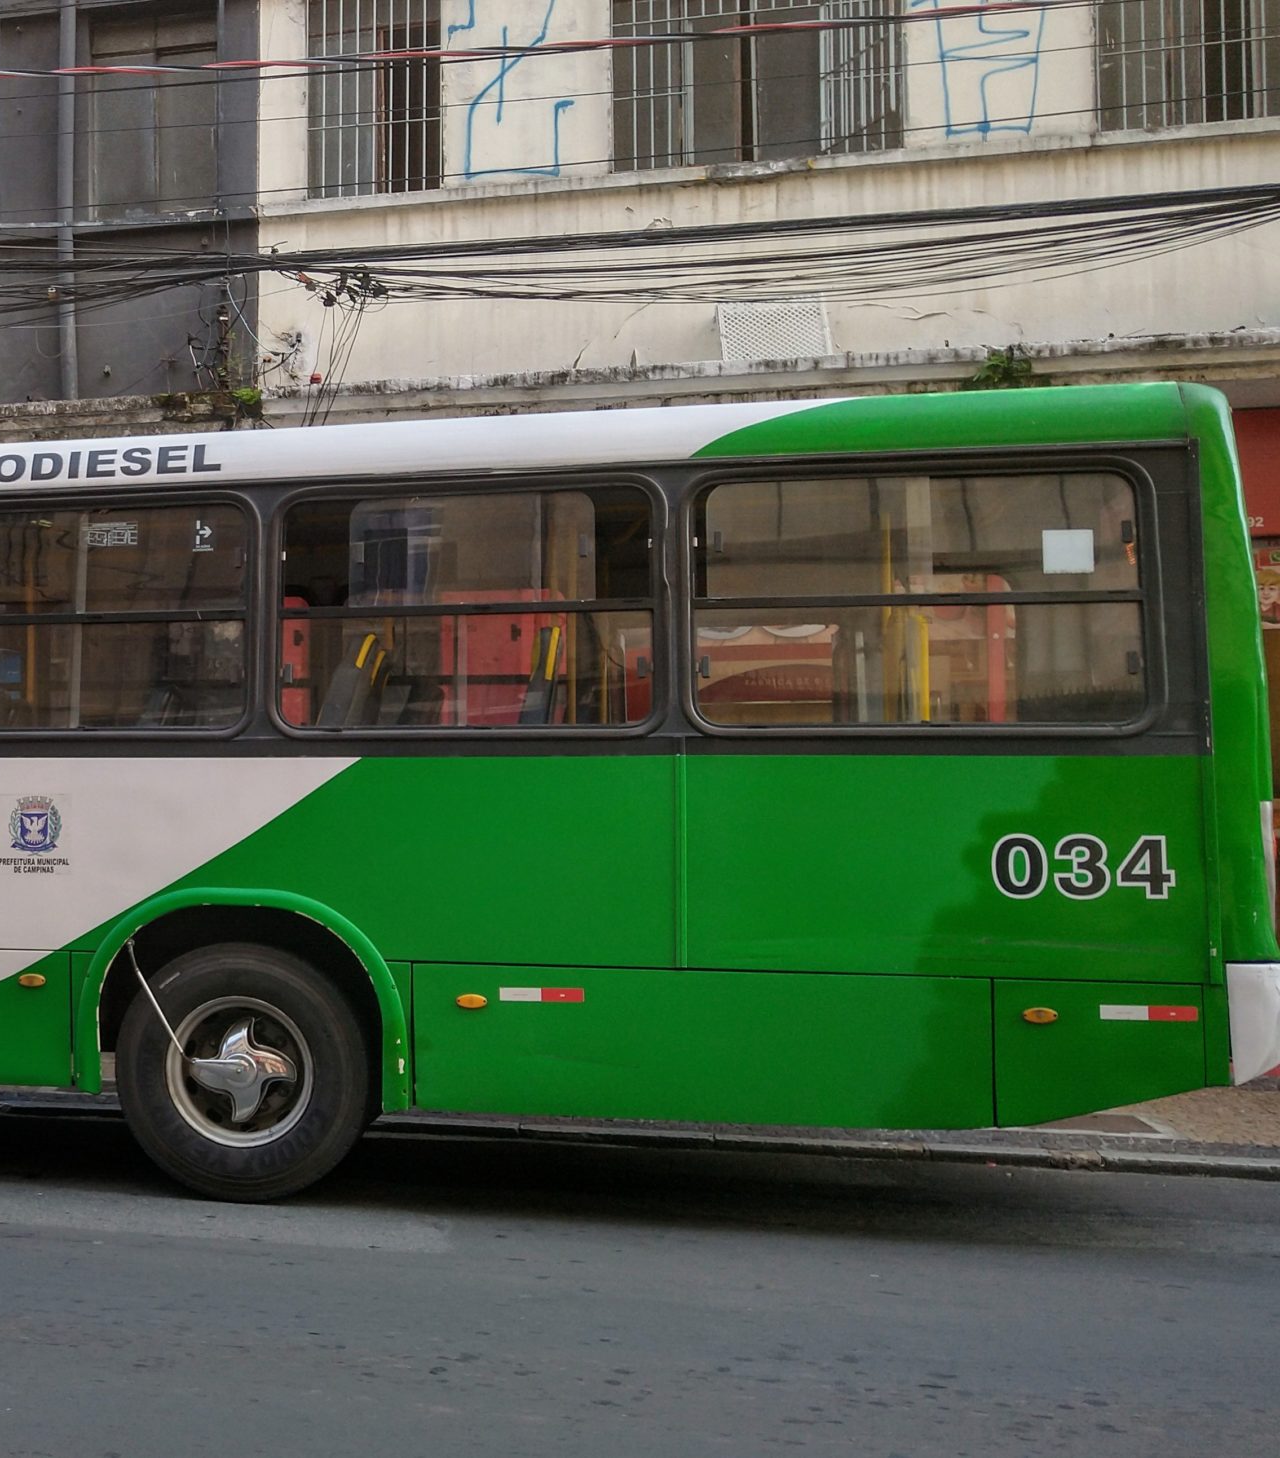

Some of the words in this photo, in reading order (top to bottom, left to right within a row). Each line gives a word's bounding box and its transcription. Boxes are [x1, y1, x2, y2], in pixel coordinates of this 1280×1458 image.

[37, 858, 70, 866] MUNICIPAL
[990, 832, 1177, 900] 034
[13, 866, 22, 874] DE
[23, 866, 55, 874] CAMPINAS
